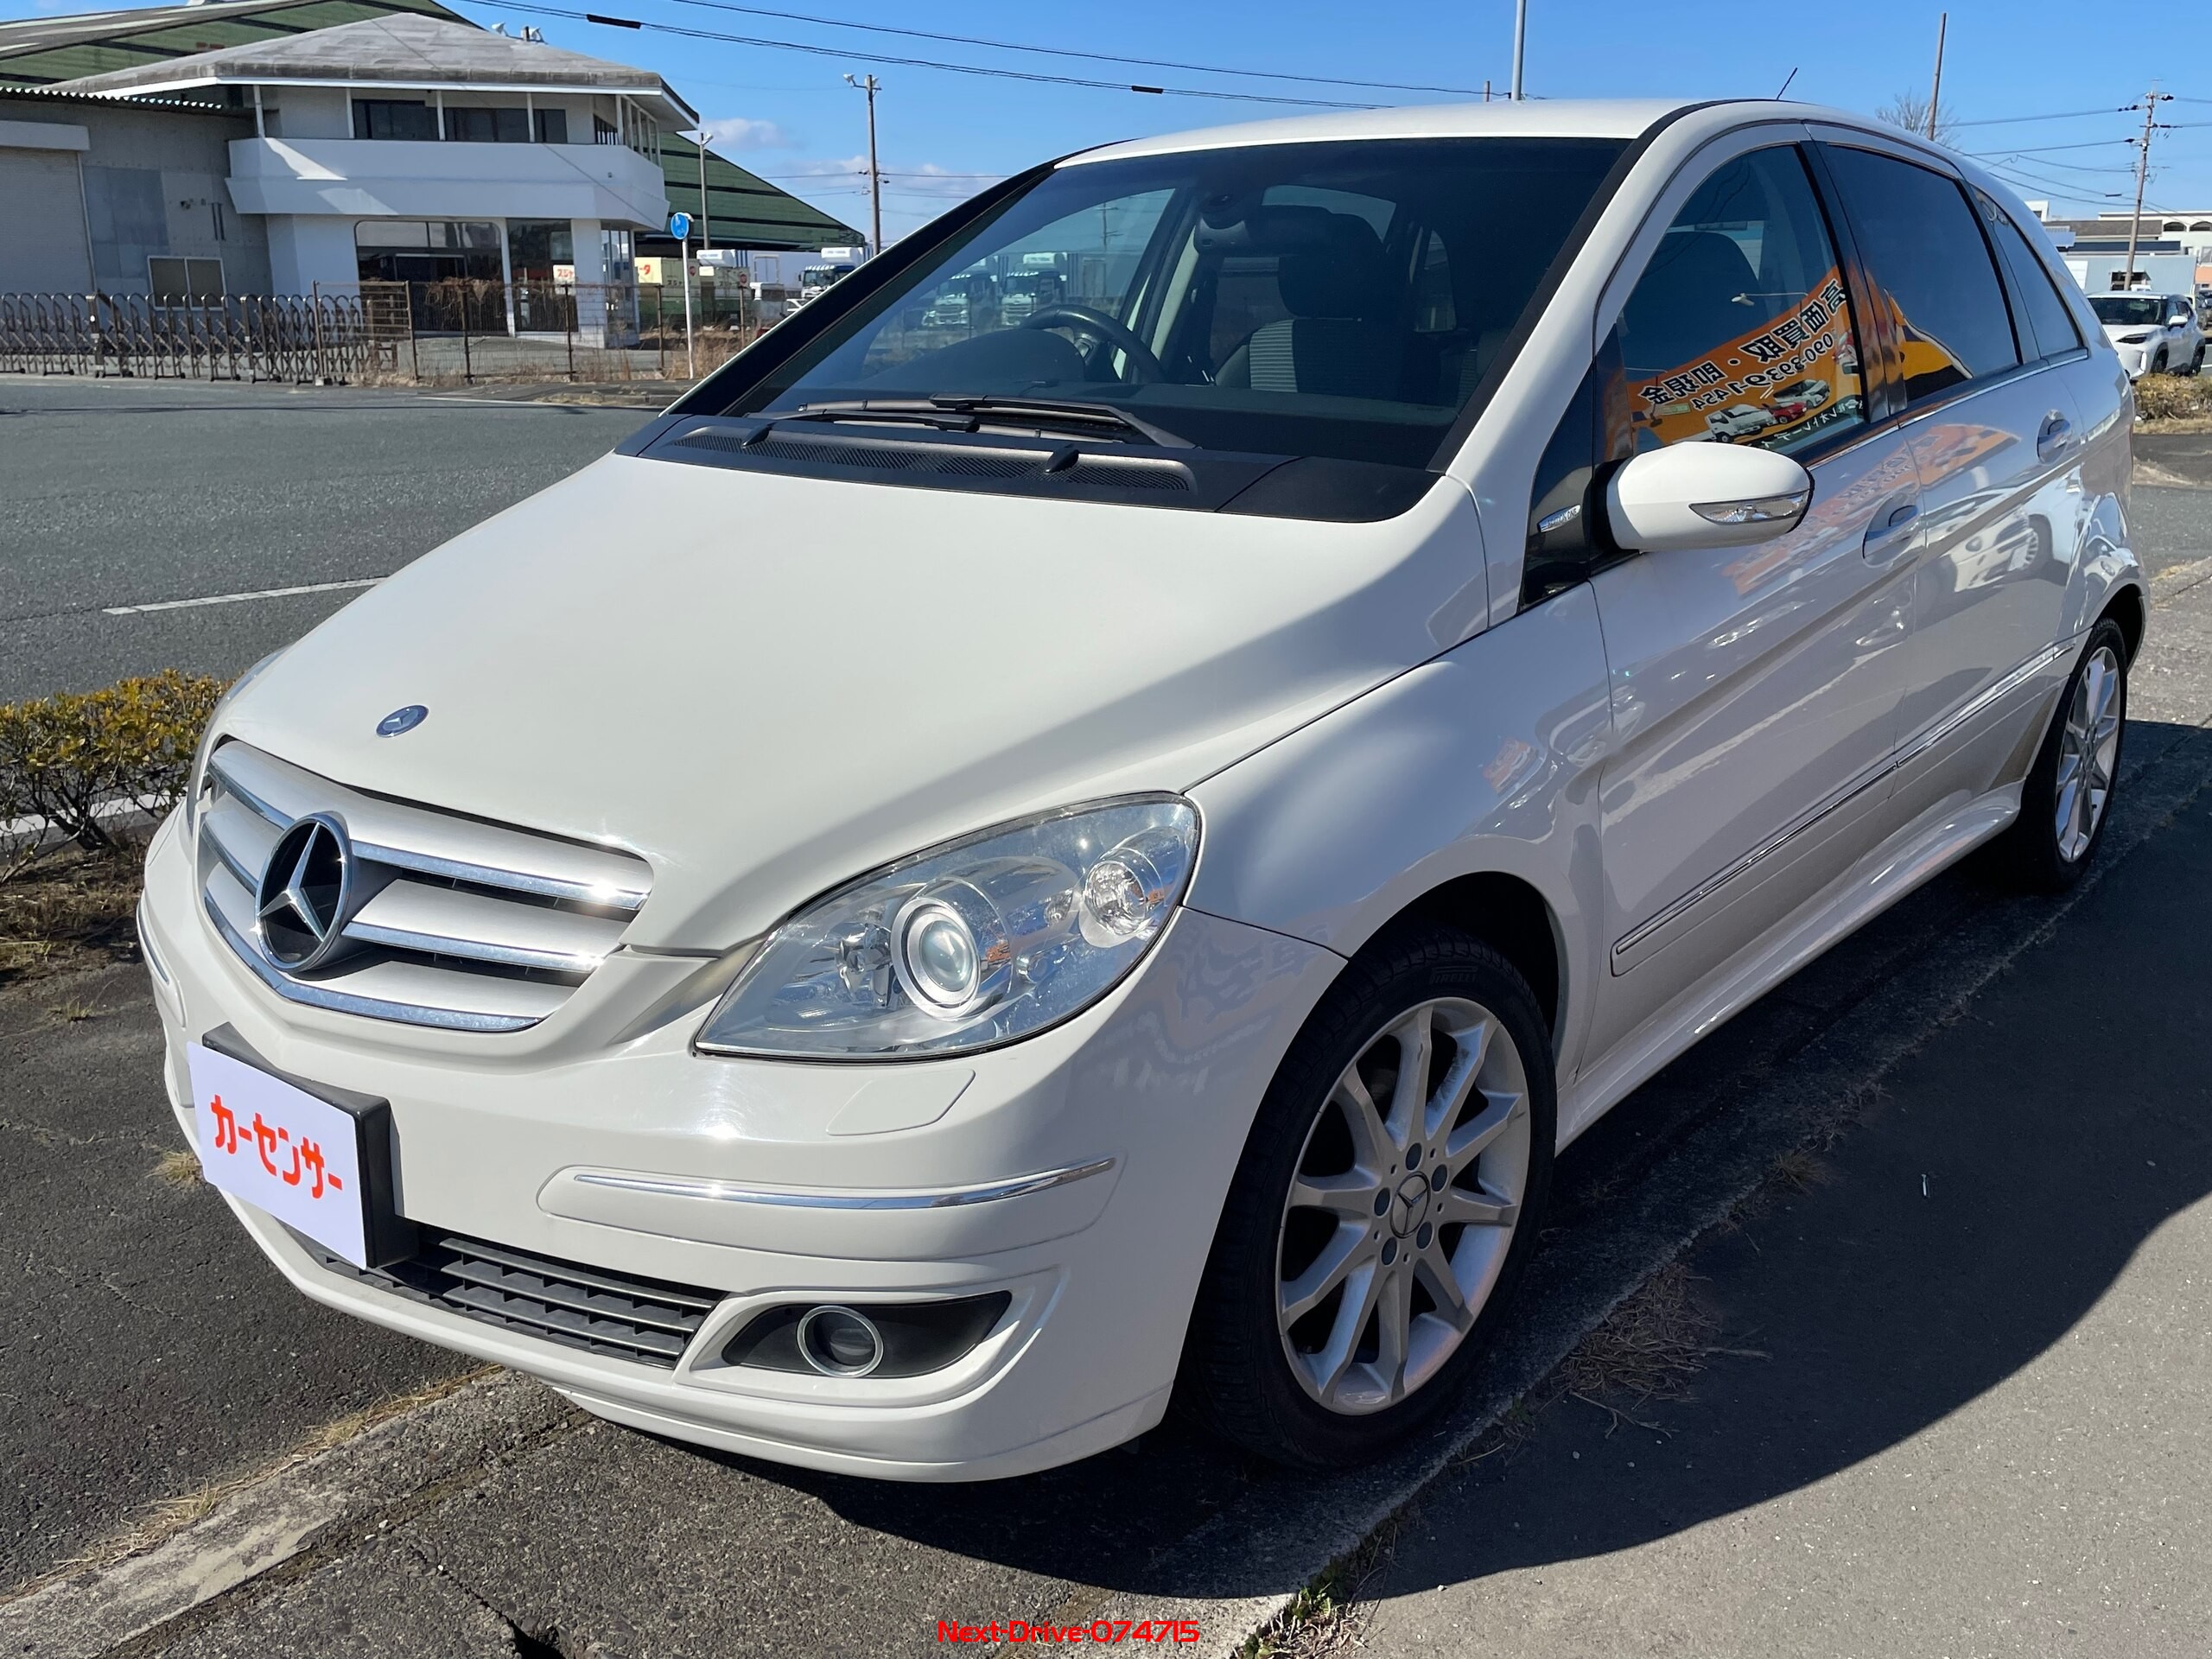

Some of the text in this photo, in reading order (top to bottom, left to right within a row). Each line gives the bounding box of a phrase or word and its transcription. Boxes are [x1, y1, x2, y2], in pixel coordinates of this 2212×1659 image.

[211, 1094, 343, 1199] カーセンサー
